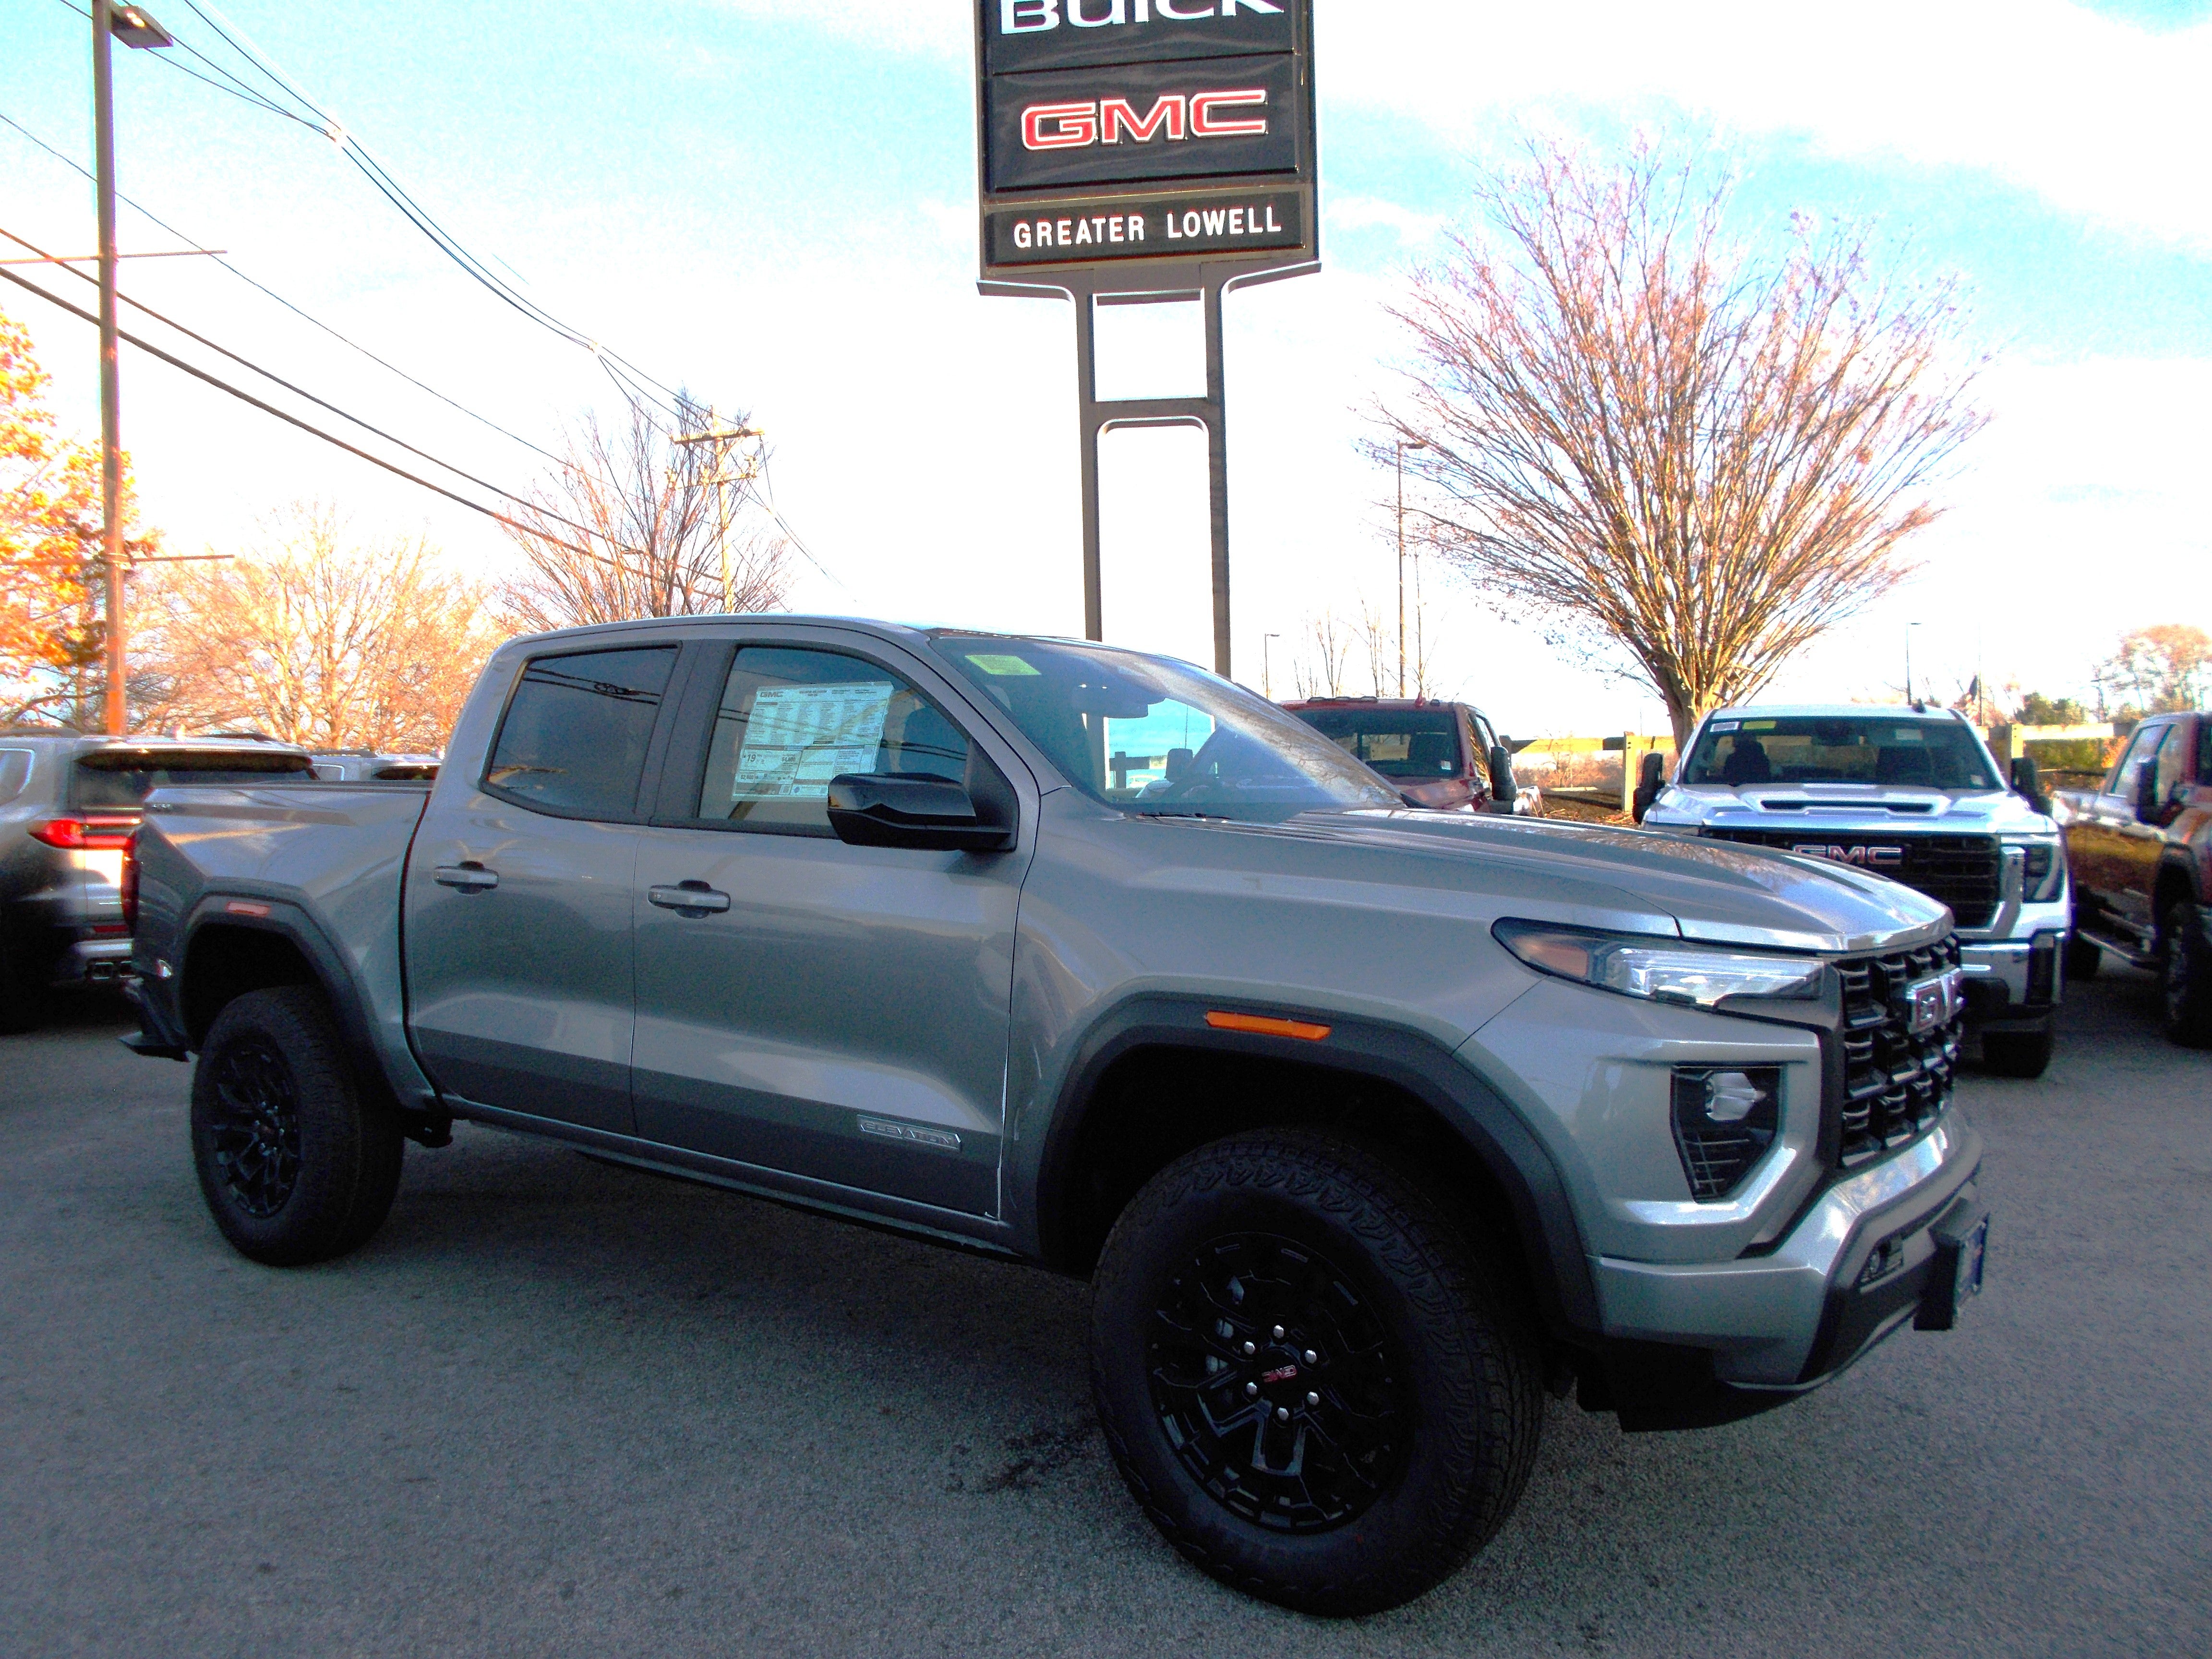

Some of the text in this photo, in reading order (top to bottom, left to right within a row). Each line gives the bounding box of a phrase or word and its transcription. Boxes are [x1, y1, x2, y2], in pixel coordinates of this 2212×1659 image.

[1021, 90, 1267, 150] GMC
[1014, 206, 1281, 248] GREATER LOWELL
[1262, 1365, 1297, 1382] GMC
